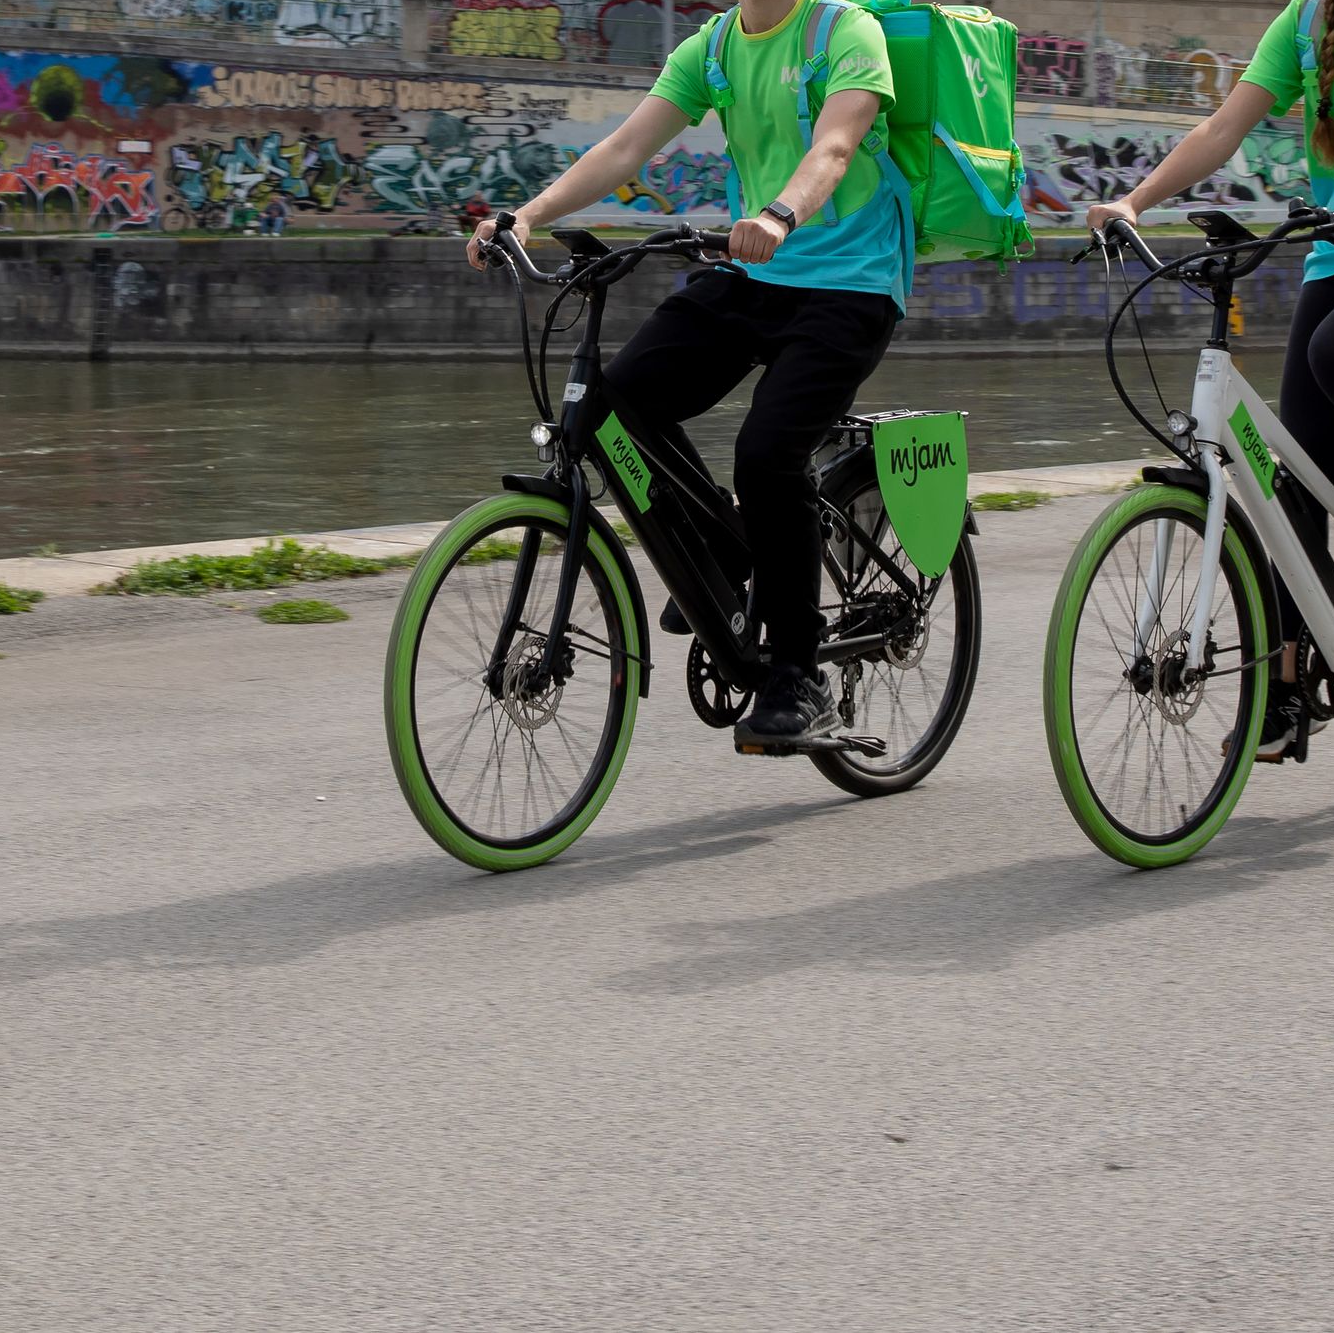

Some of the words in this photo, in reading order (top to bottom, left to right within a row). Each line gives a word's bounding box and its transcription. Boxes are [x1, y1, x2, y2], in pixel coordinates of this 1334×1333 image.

[612, 435, 644, 488] mjam
[890, 436, 956, 487] mjam
[1242, 422, 1269, 475] mjam
